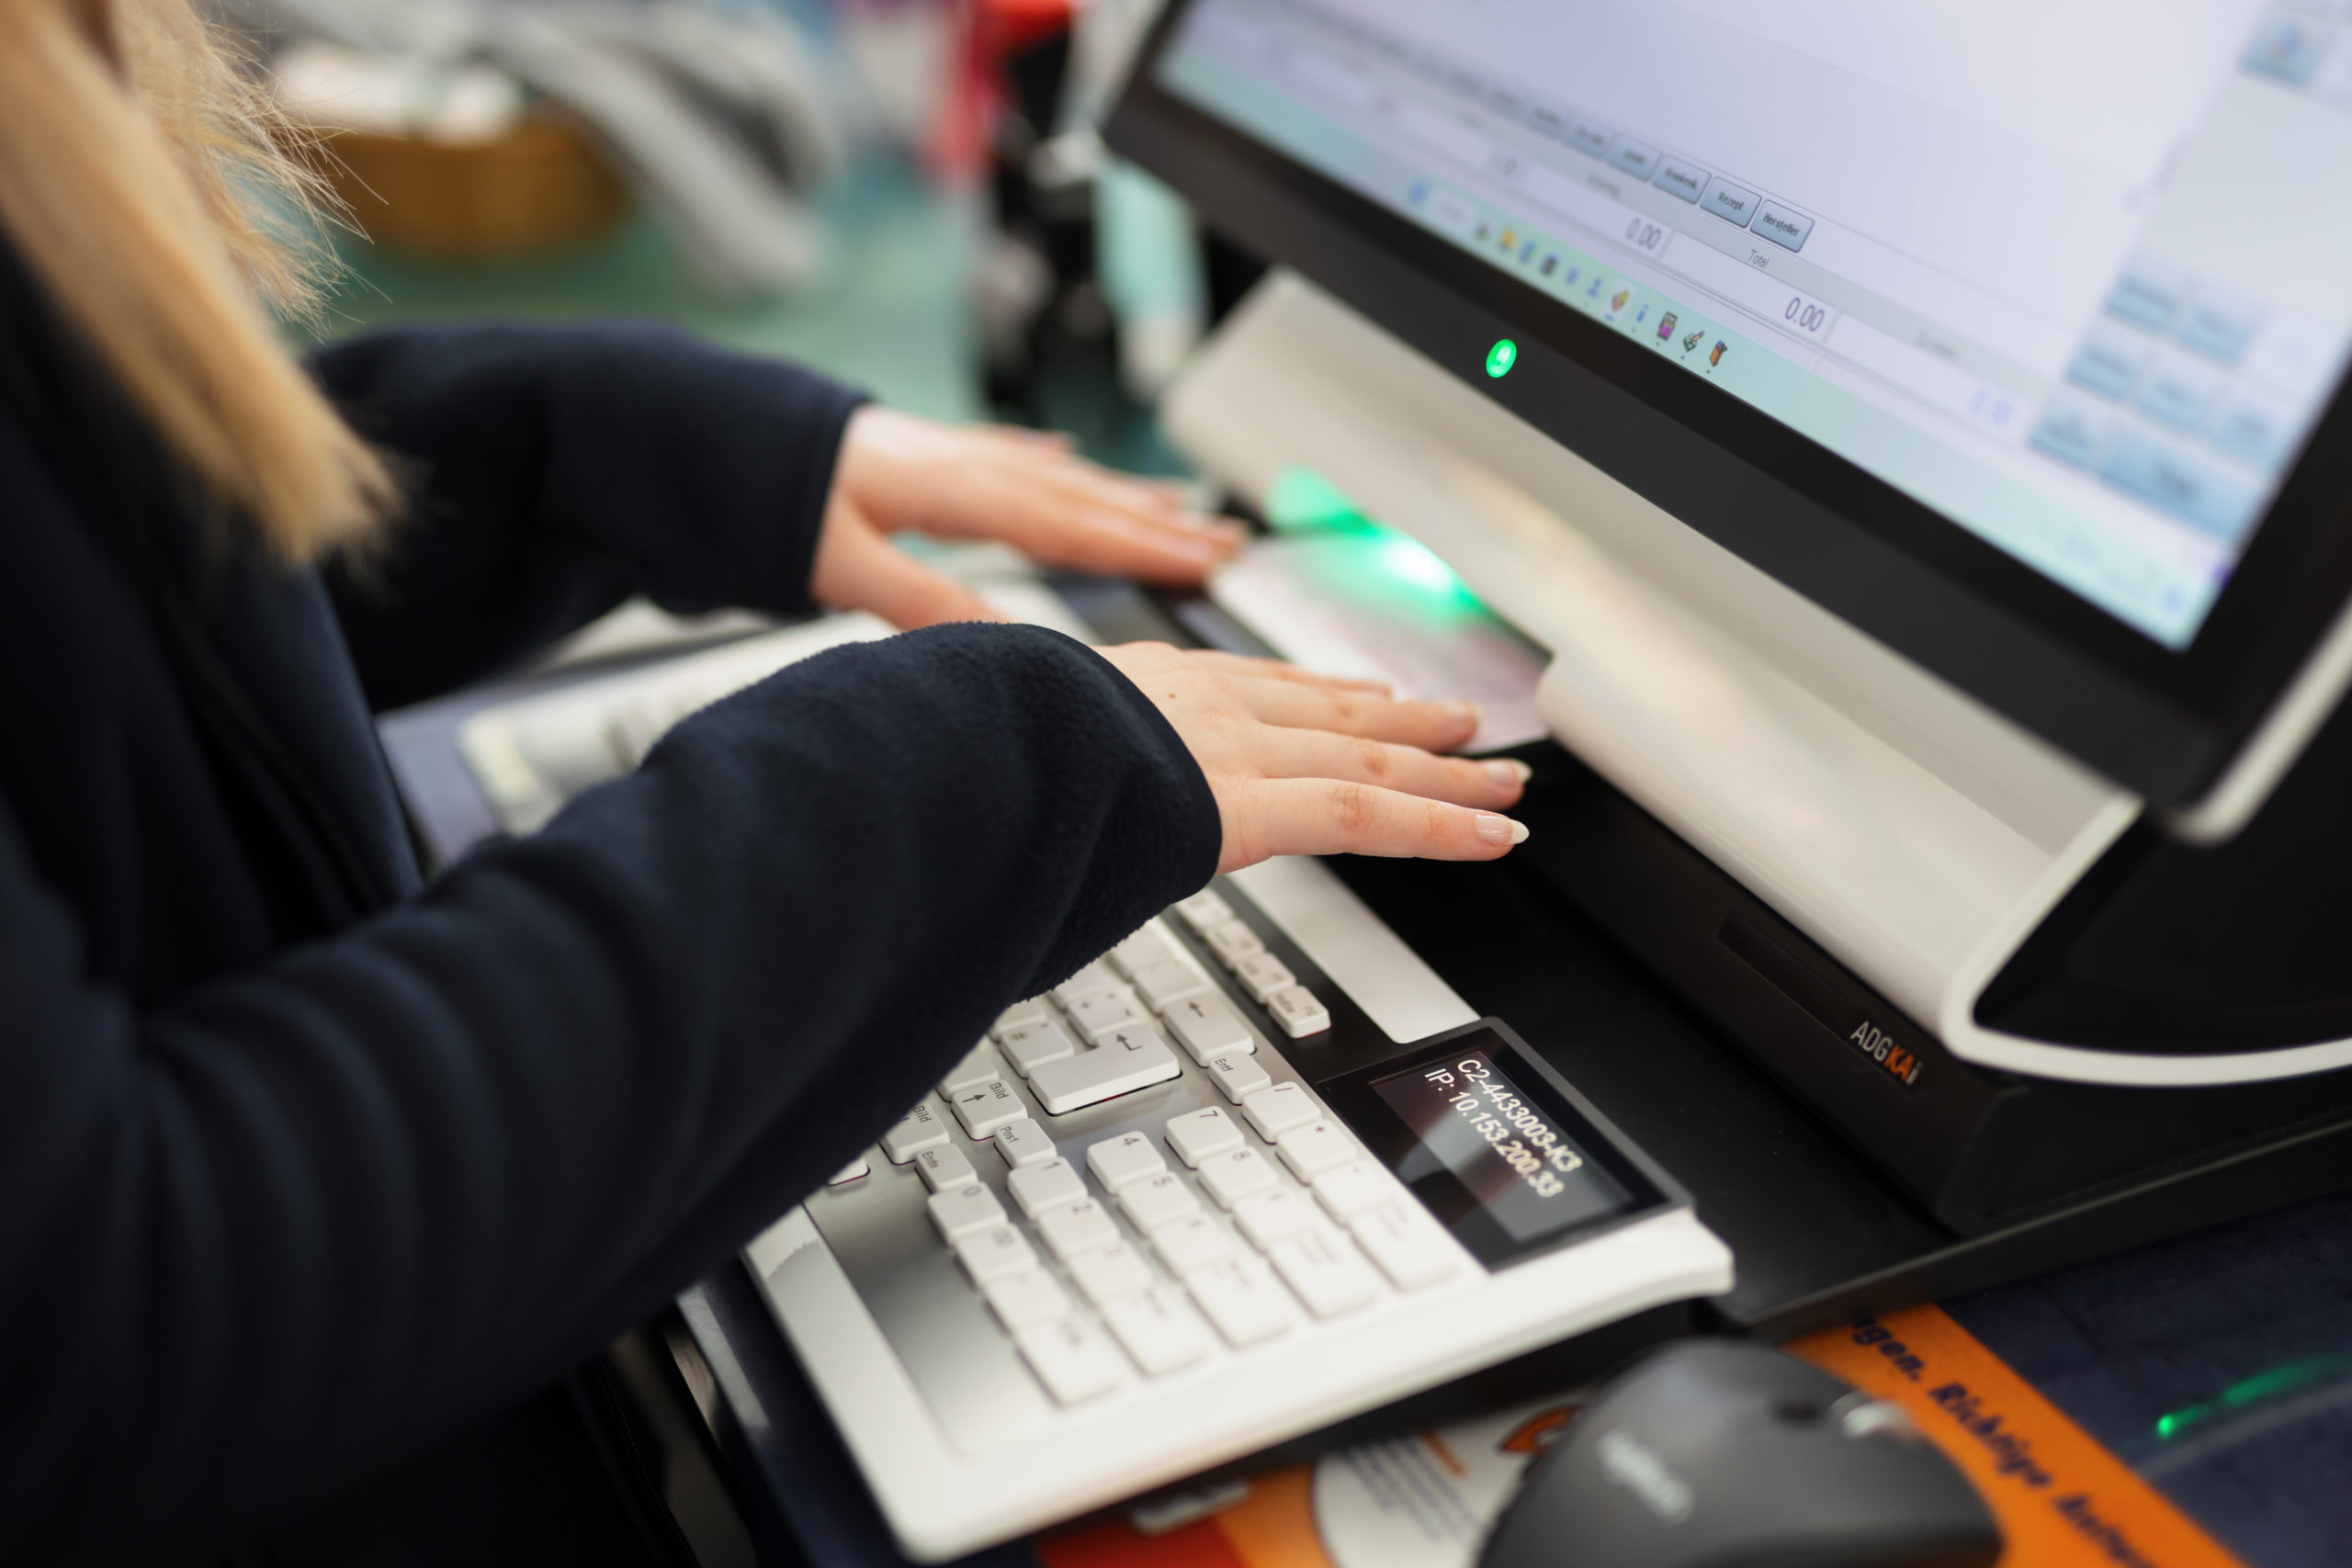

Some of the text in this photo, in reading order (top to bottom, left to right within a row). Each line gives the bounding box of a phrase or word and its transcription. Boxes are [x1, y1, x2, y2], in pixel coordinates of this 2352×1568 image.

[1716, 190, 1745, 212] Rezept
[1624, 216, 1662, 251] 0.00
[1761, 211, 1801, 237] Hersteller
[1748, 248, 1770, 269] Total
[1784, 296, 1826, 333] 0.00
[1214, 1057, 1235, 1073] Entf
[989, 1081, 1010, 1100] Bild
[913, 1104, 933, 1123] Bild
[1198, 1109, 1219, 1119] 7
[1457, 1059, 1583, 1172] C2-4433003-K3
[1000, 1125, 1020, 1144] Pos1
[1122, 1136, 1141, 1146] 4
[1424, 1068, 1565, 1198] IP: 10.153.200.33
[921, 1149, 939, 1169] Ende
